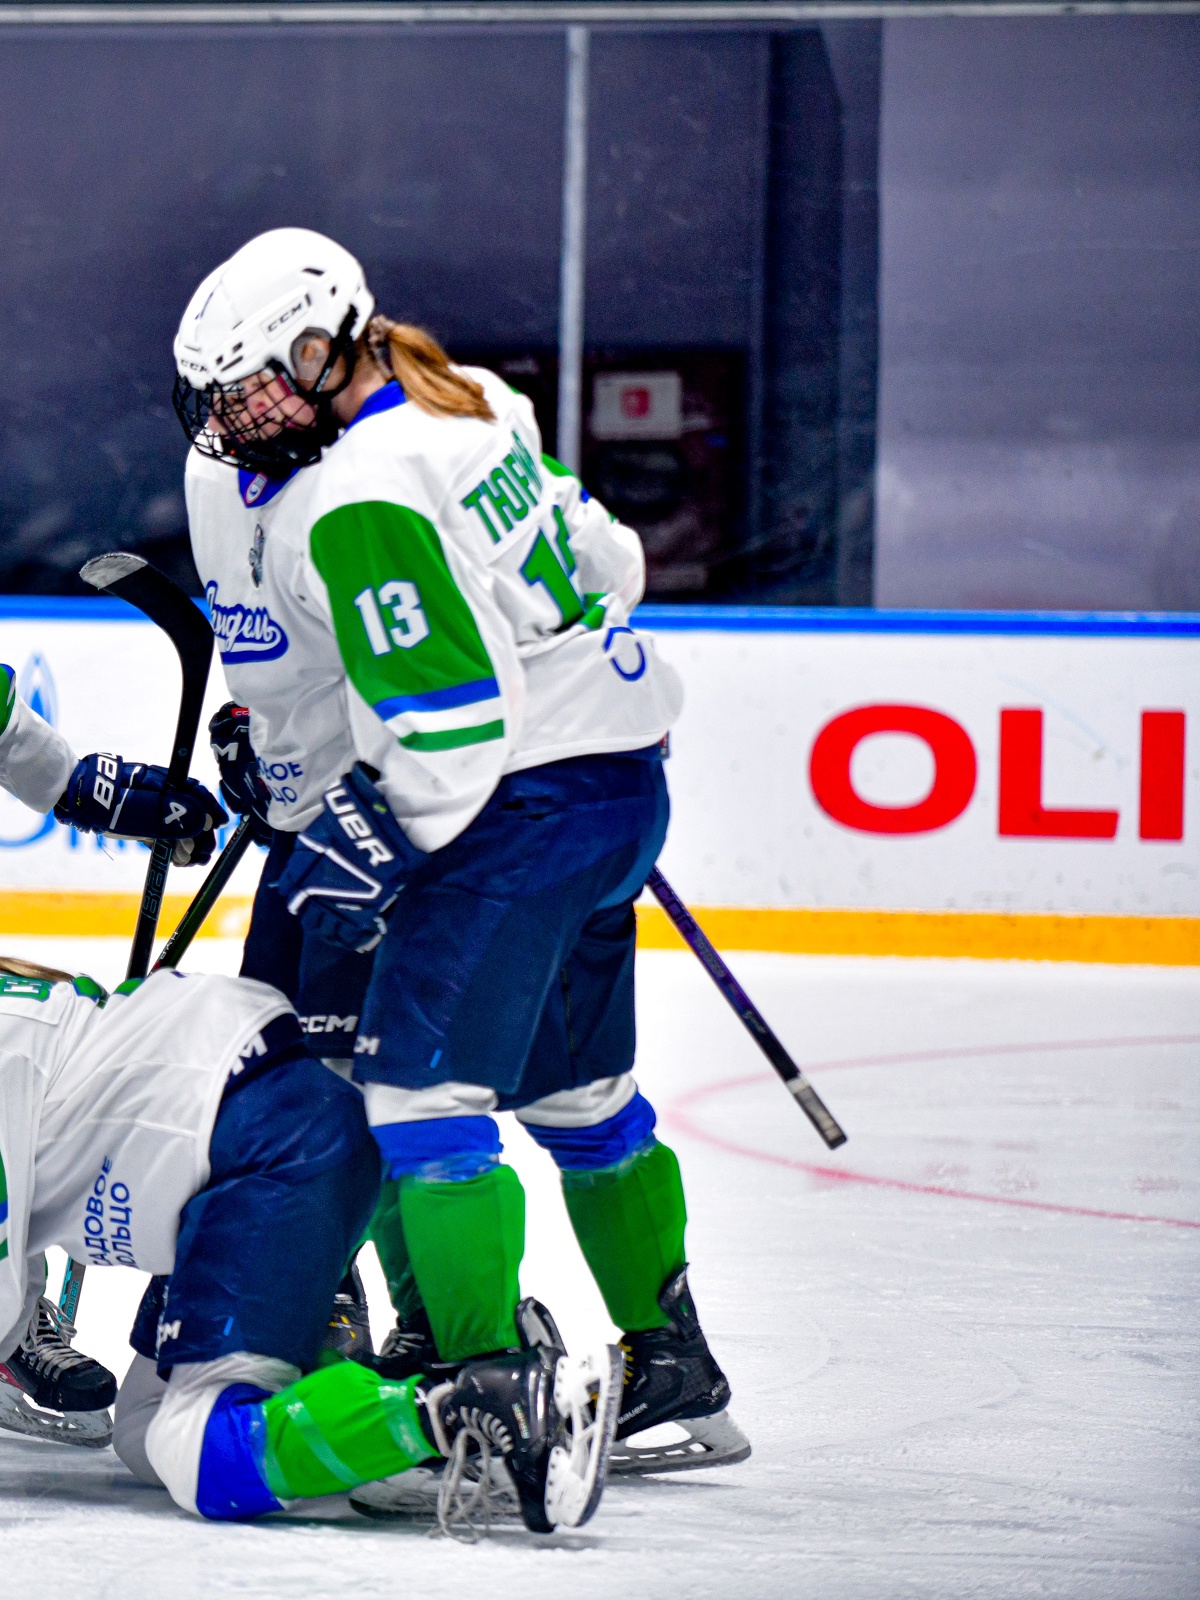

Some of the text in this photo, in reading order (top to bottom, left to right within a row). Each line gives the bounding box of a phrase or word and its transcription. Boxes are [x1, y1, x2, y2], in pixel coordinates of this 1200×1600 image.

[353, 579, 431, 658] 13
[807, 699, 1187, 843] OLI
[110, 1182, 139, 1269] ОЛЬЦО
